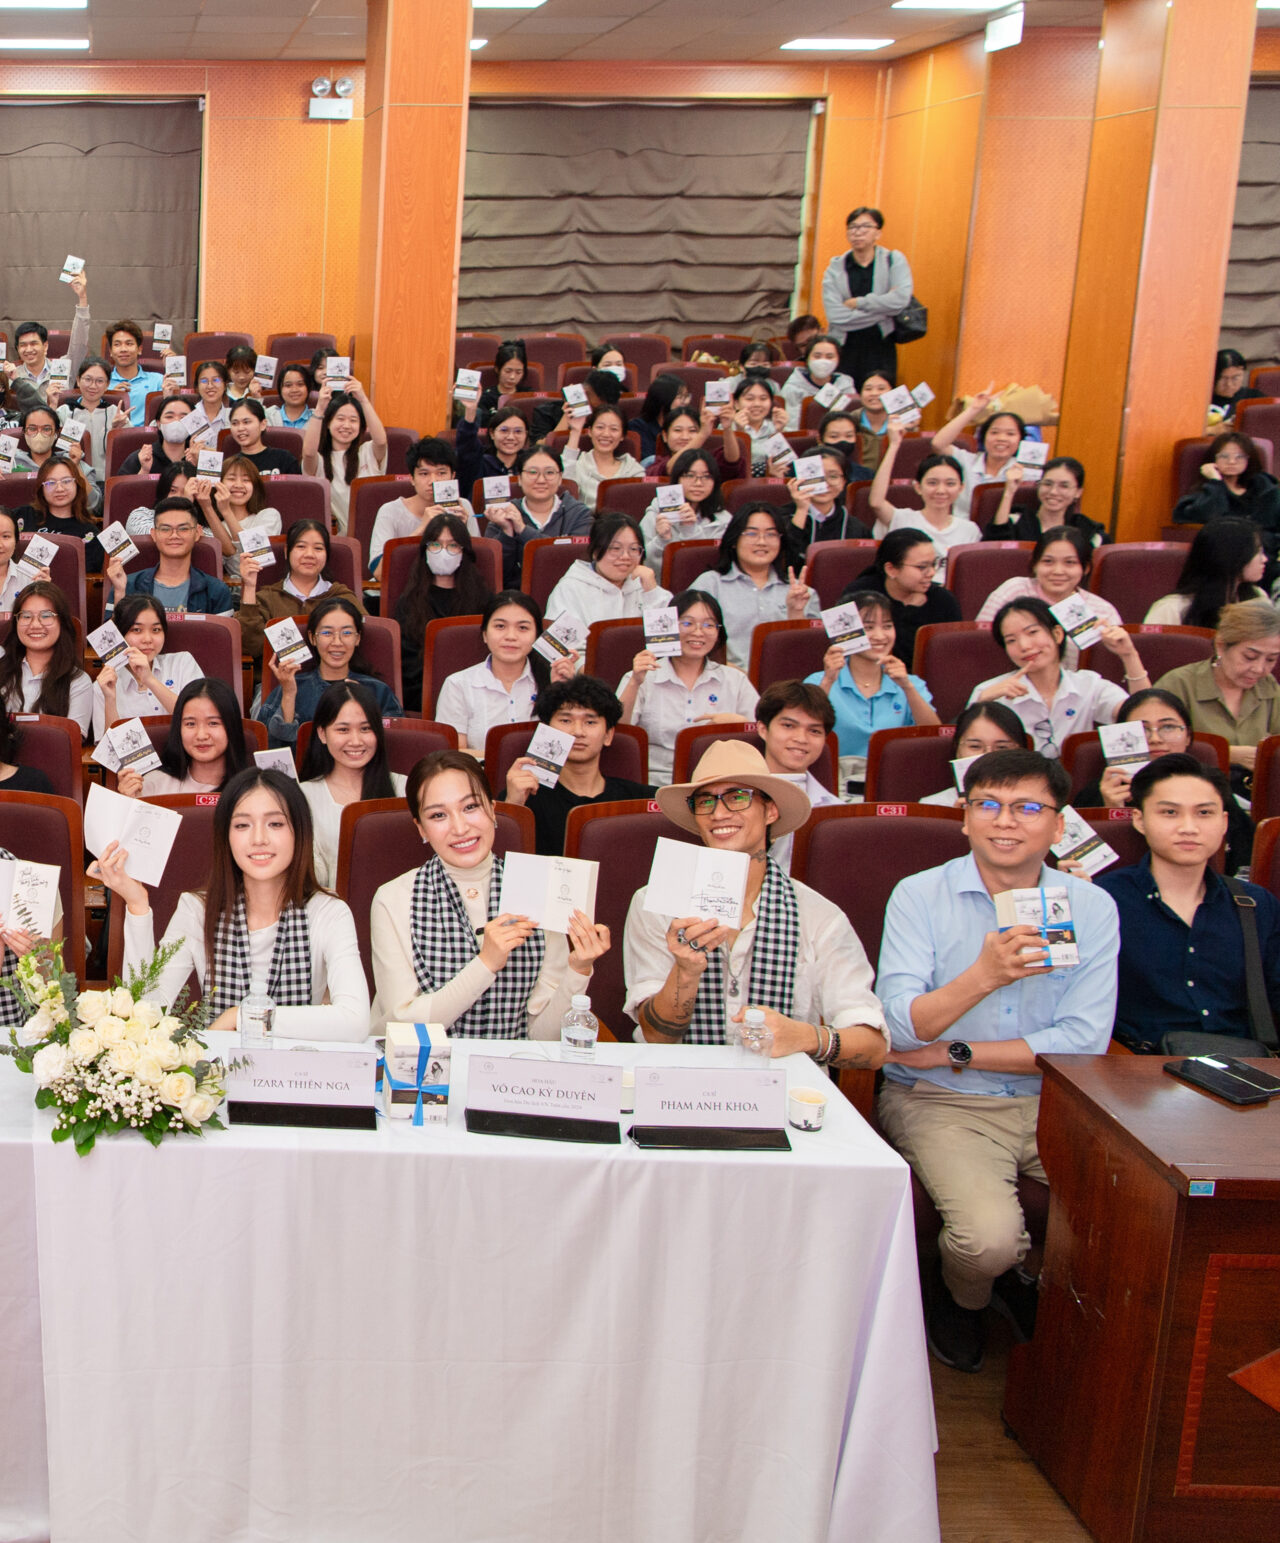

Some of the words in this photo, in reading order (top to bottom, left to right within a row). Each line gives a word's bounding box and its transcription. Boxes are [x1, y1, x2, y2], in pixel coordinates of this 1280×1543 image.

[879, 806, 905, 815] C31
[252, 1079, 284, 1089] IZARA
[287, 1079, 322, 1090] THIÊN
[326, 1082, 350, 1091] NGA
[511, 1086, 535, 1096] CAO
[556, 1089, 596, 1101] DUYÊN
[660, 1100, 693, 1112] PHẠM
[696, 1102, 722, 1111] ANH
[725, 1102, 759, 1112] KHOA
